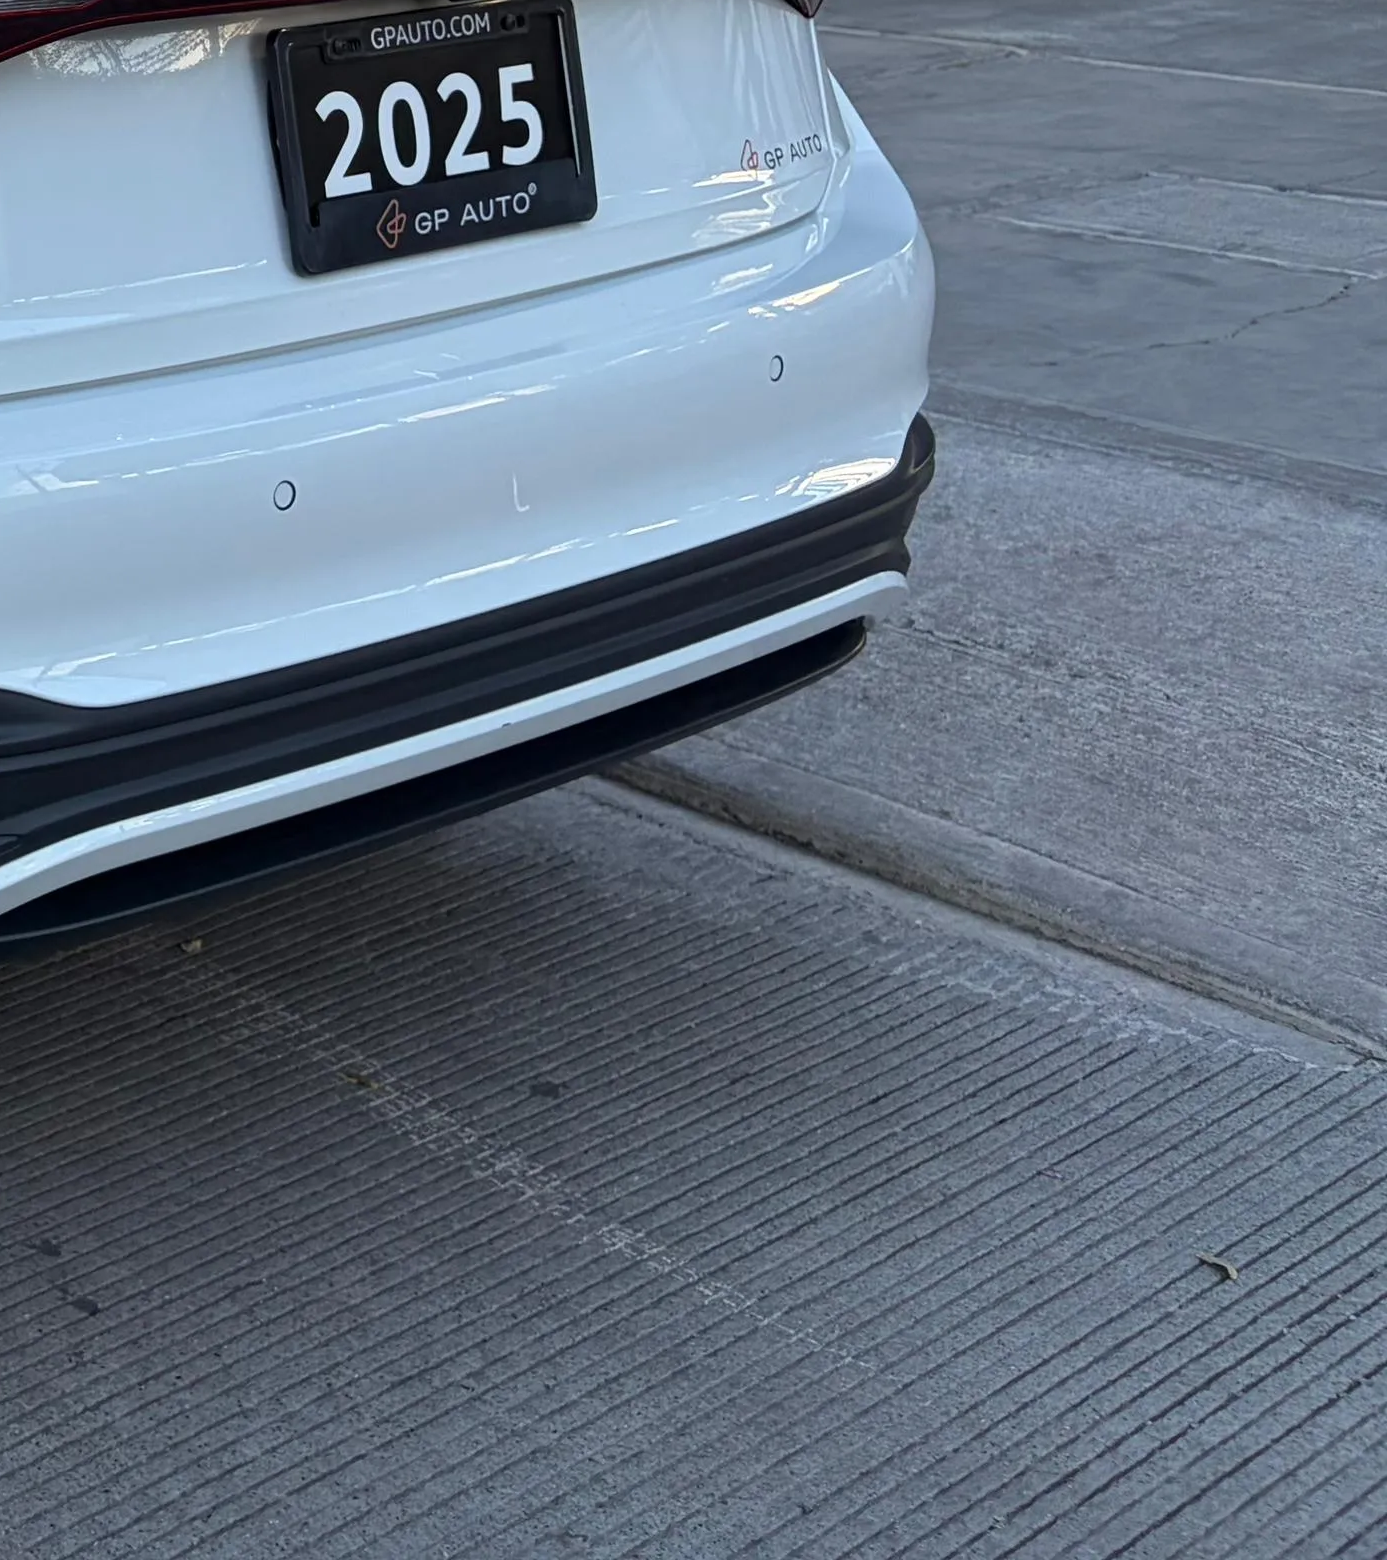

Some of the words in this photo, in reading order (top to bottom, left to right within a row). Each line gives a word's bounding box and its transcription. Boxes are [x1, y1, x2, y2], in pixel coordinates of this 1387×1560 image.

[370, 11, 491, 50] GPAUTO.COM
[315, 62, 544, 199] 2025
[764, 147, 784, 170] GP
[790, 134, 823, 163] AUTO
[414, 208, 450, 235] GP
